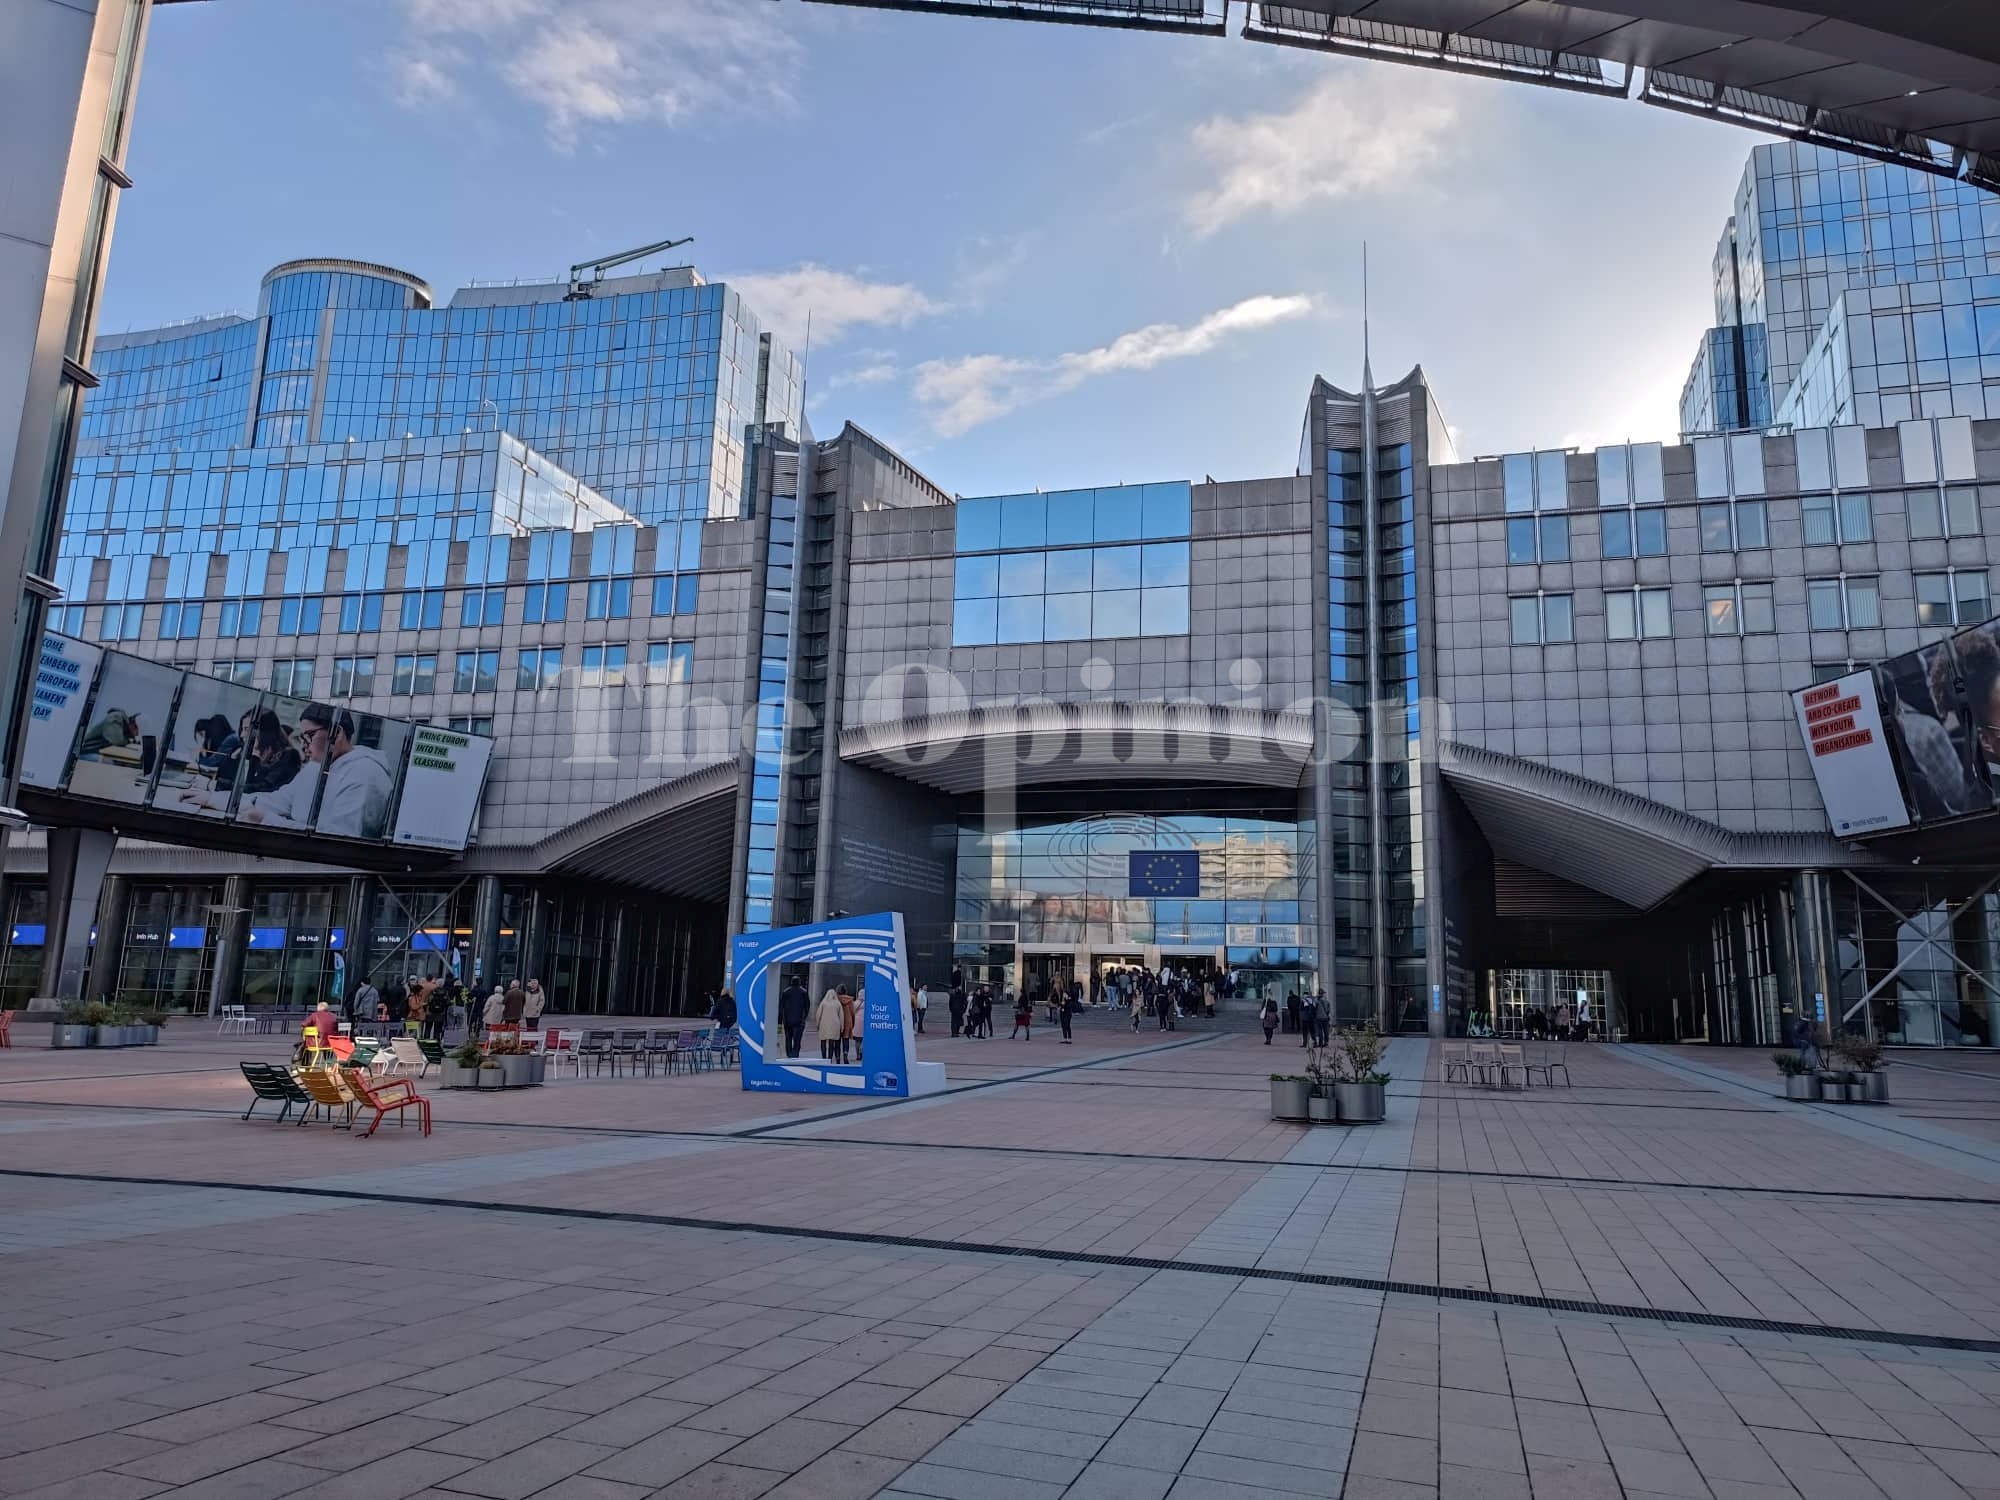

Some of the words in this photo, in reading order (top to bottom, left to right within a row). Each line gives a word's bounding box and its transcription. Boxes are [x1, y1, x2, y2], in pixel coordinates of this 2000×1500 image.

[42, 637, 64, 652] COME
[40, 654, 69, 671] EMBER
[68, 663, 80, 674] OF
[36, 671, 80, 692] EUROPEAN
[35, 688, 67, 706] IAMENT
[1805, 687, 1838, 705] NETWORK
[33, 705, 51, 718] DAY
[1808, 710, 1822, 721] AND
[1823, 697, 1860, 717] CO-CREATE
[1812, 725, 1829, 738] WITH
[1829, 718, 1854, 733] YOUTH
[419, 731, 441, 742] BRING
[442, 734, 468, 747] EUROPE
[1815, 731, 1871, 754] ORGANISATIONS
[416, 744, 434, 754] INTO
[434, 746, 449, 757] THE
[414, 757, 455, 770] CLASSROOM
[871, 1004, 888, 1012] Your
[870, 1012, 890, 1021] voice
[870, 1022, 899, 1030] matters
